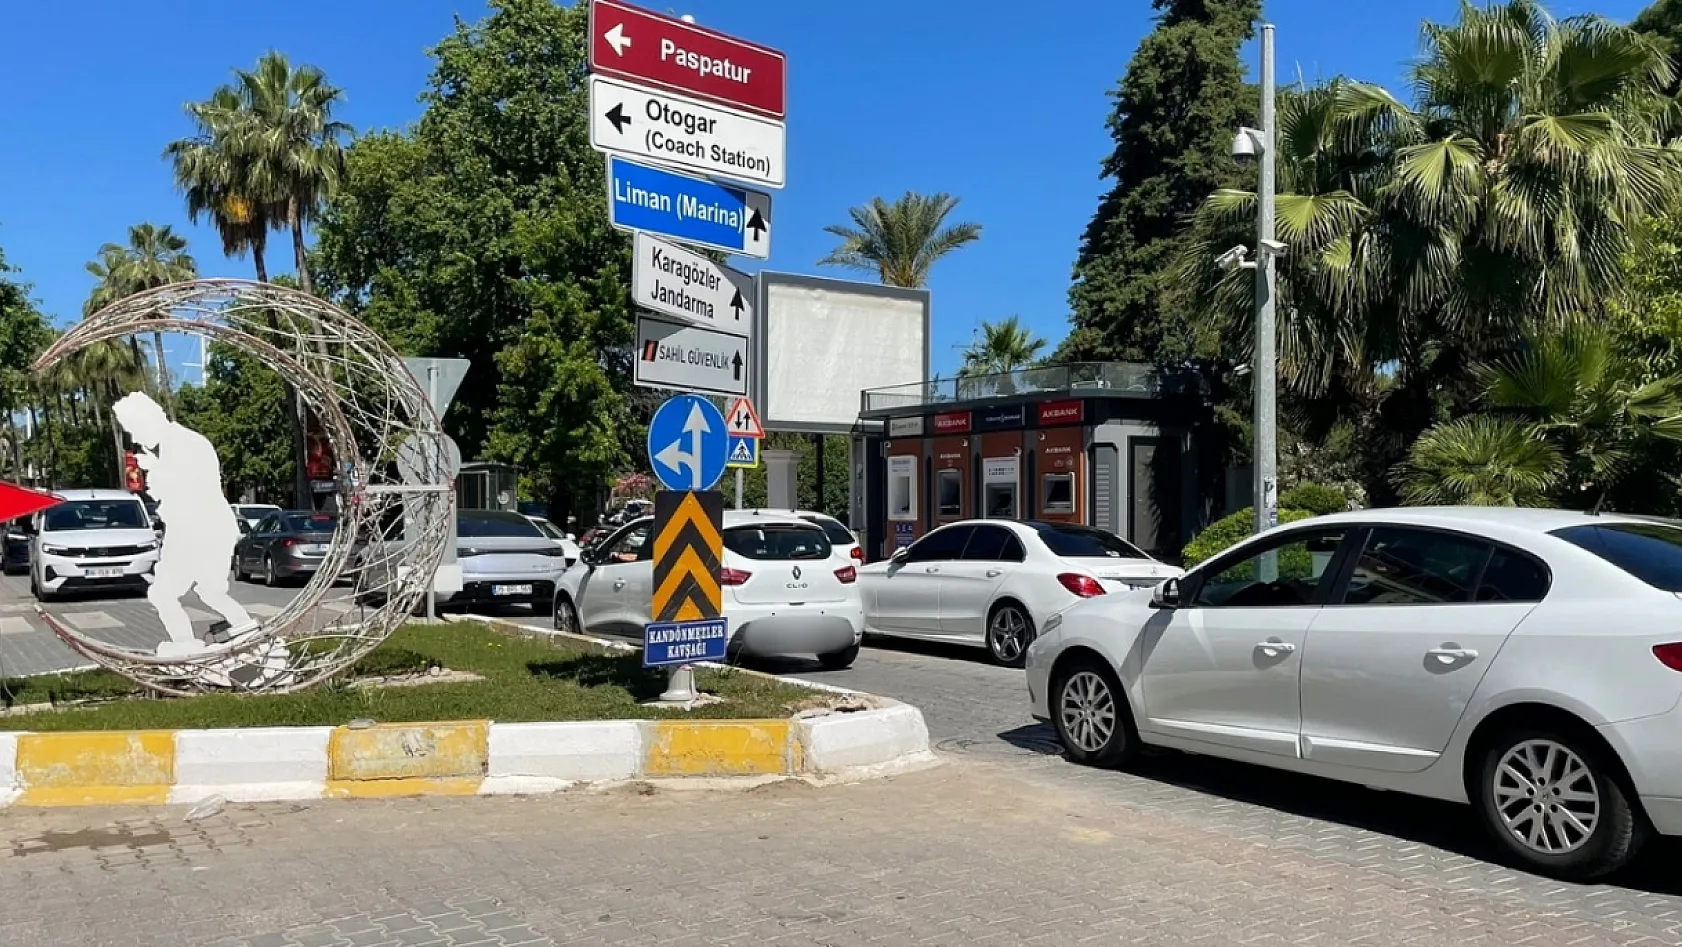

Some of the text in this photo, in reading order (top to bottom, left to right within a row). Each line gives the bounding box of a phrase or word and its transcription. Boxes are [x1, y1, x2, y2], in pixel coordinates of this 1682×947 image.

[661, 38, 752, 84] Paspatur
[645, 99, 717, 135] Otogar
[645, 129, 771, 176] (Coach Station)
[615, 178, 743, 234] Liman (Marina)
[652, 246, 722, 292] Karagözler
[651, 279, 714, 319] Jandarma
[659, 344, 730, 371] SAHİL GÜVENLİK
[937, 418, 967, 428] AKBANK
[1042, 407, 1078, 418] AKBANK
[667, 640, 707, 659] KAVŞAĞI
